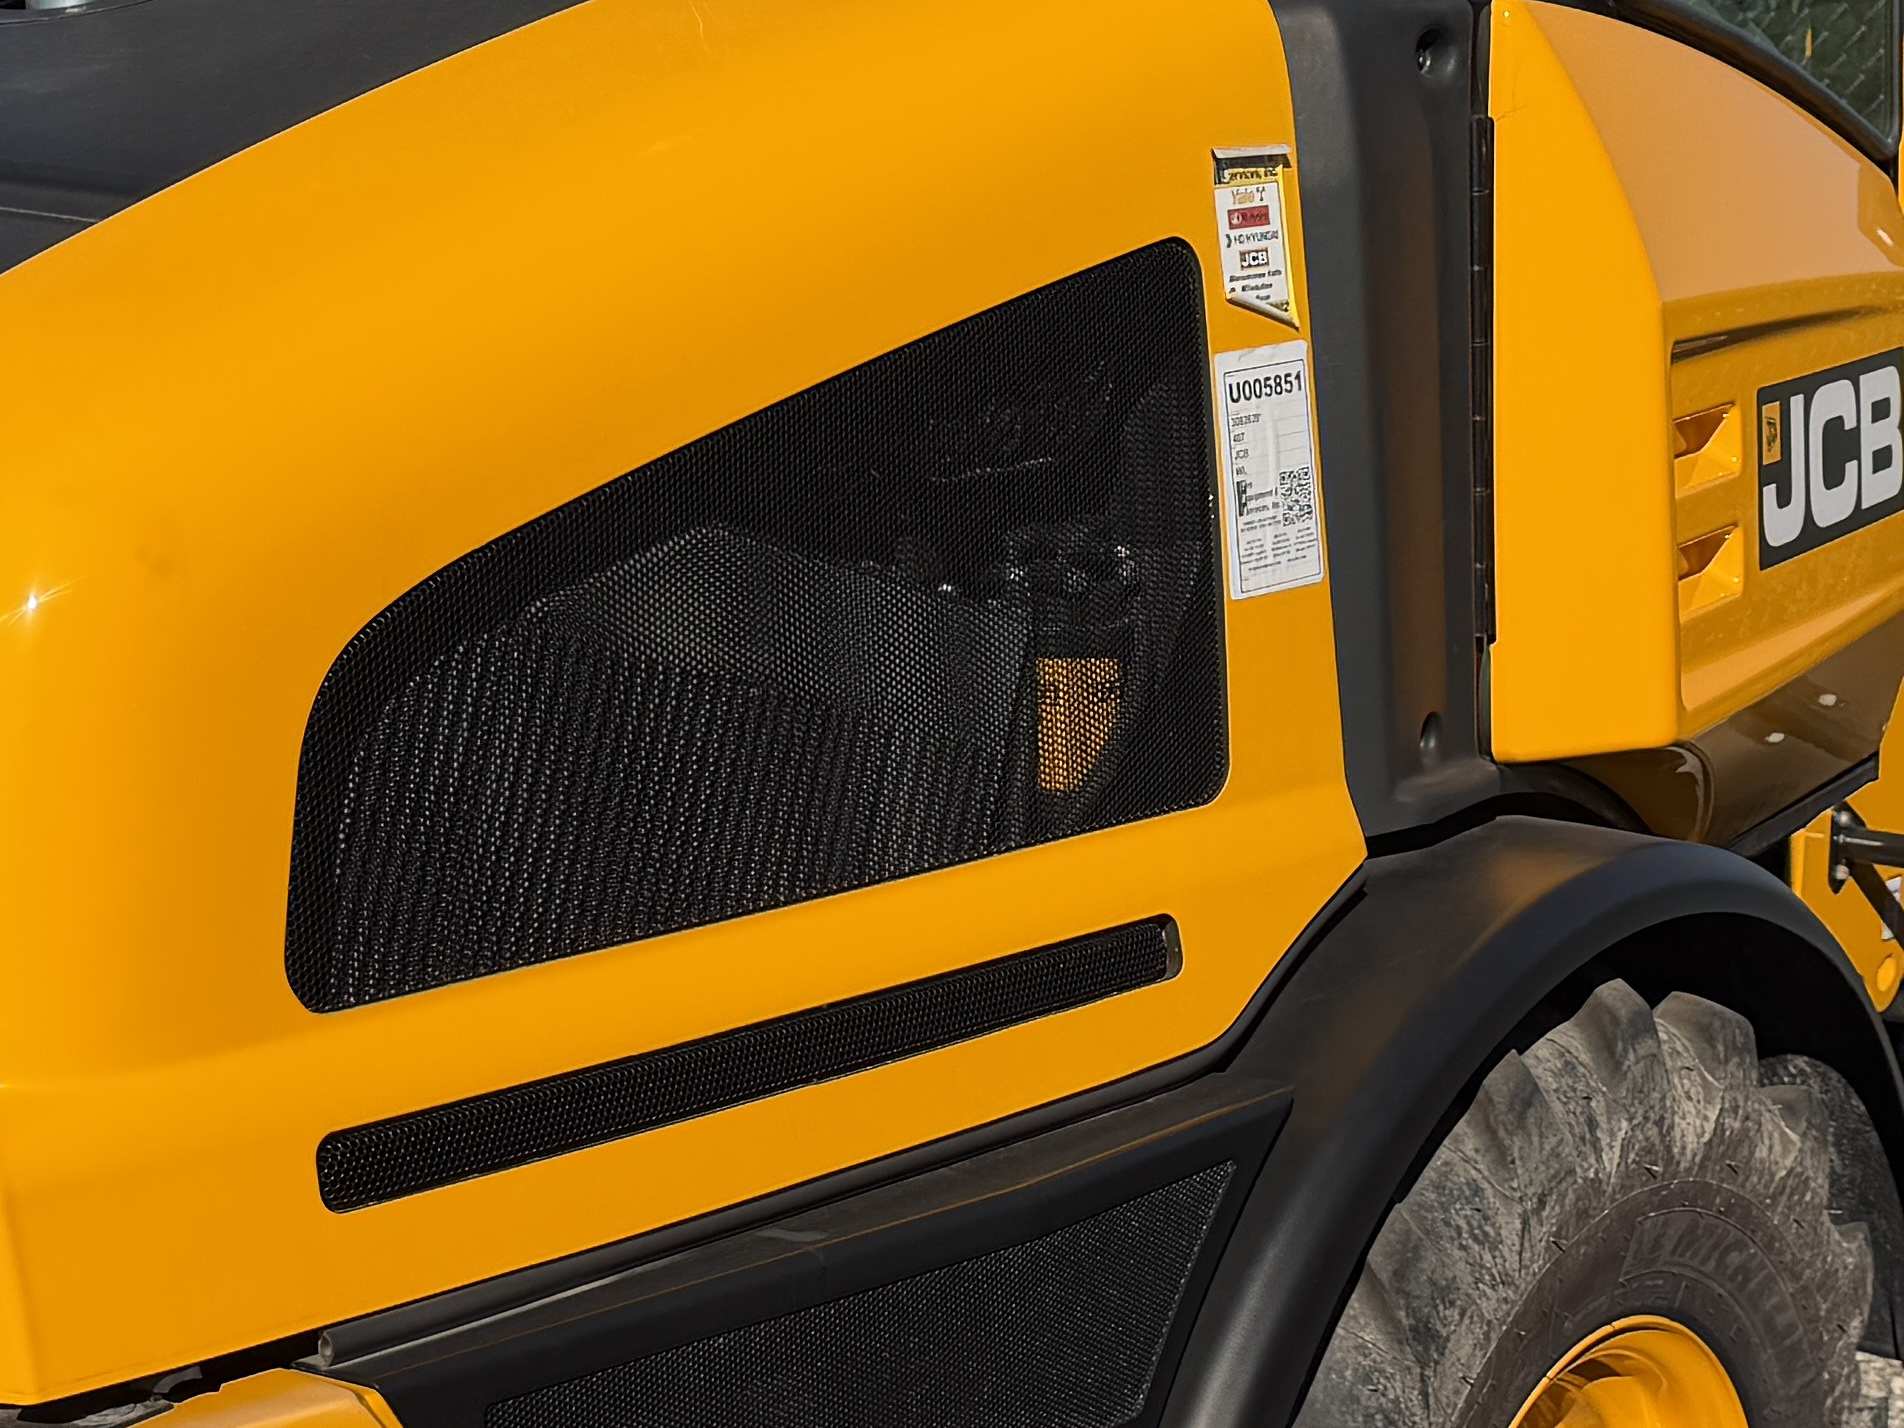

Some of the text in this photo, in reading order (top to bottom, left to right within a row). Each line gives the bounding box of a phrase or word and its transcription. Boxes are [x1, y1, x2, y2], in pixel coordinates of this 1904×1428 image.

[1241, 251, 1268, 267] JCB
[1228, 370, 1302, 404] U005851
[1762, 365, 1904, 547] JCB
